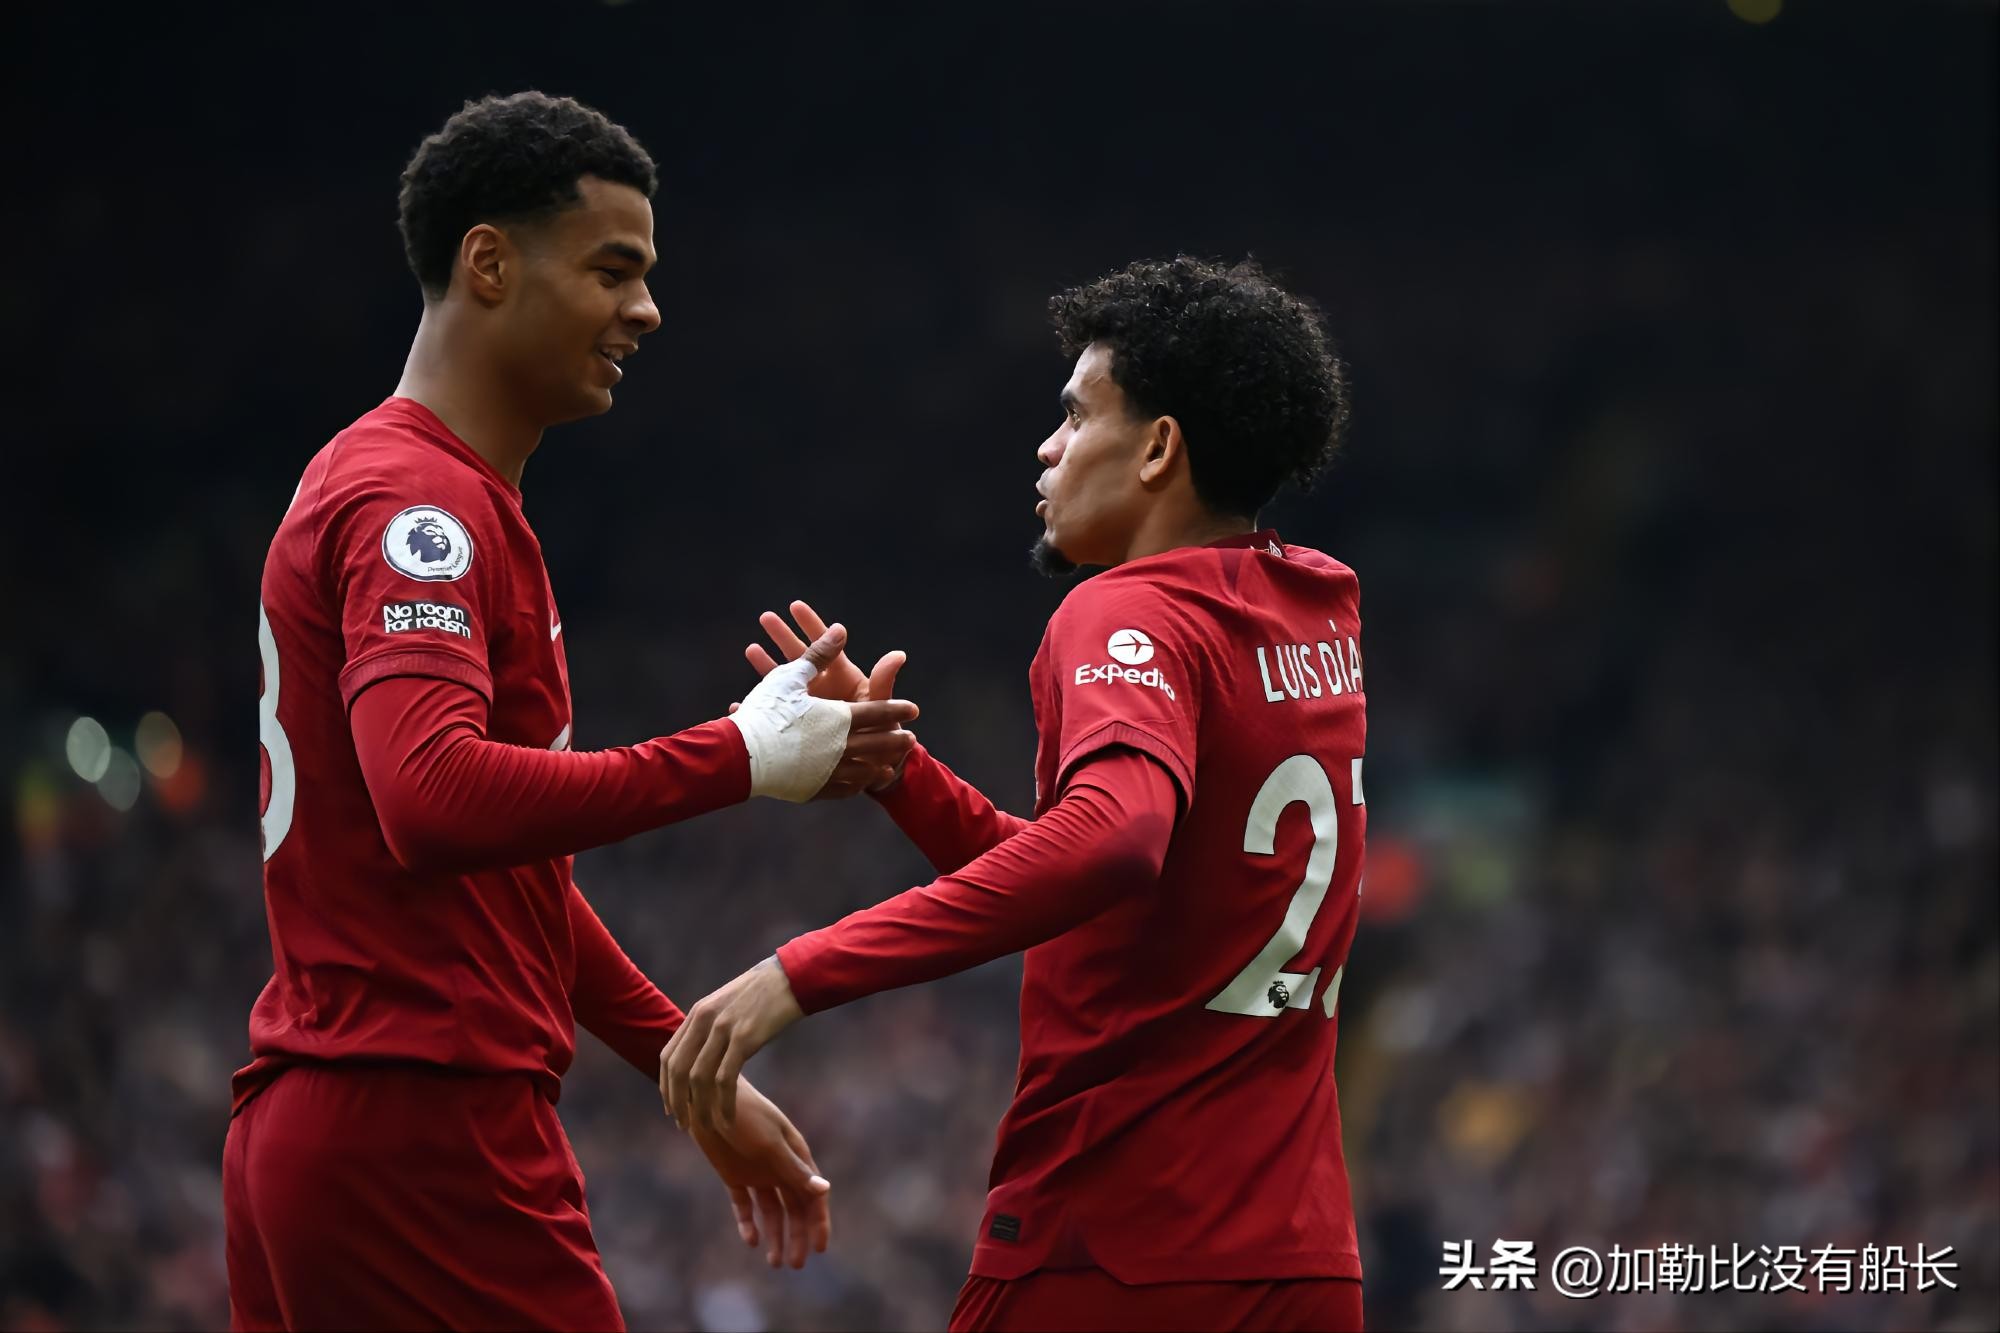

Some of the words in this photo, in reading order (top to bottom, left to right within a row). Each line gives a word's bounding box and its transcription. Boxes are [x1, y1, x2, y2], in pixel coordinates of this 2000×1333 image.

[383, 604, 413, 621] No
[415, 603, 464, 623] room
[384, 618, 413, 634] for
[416, 616, 471, 640] racism
[1075, 663, 1176, 702] Expedia
[1257, 644, 1322, 703] LUIS
[1205, 754, 1365, 1019] 2
